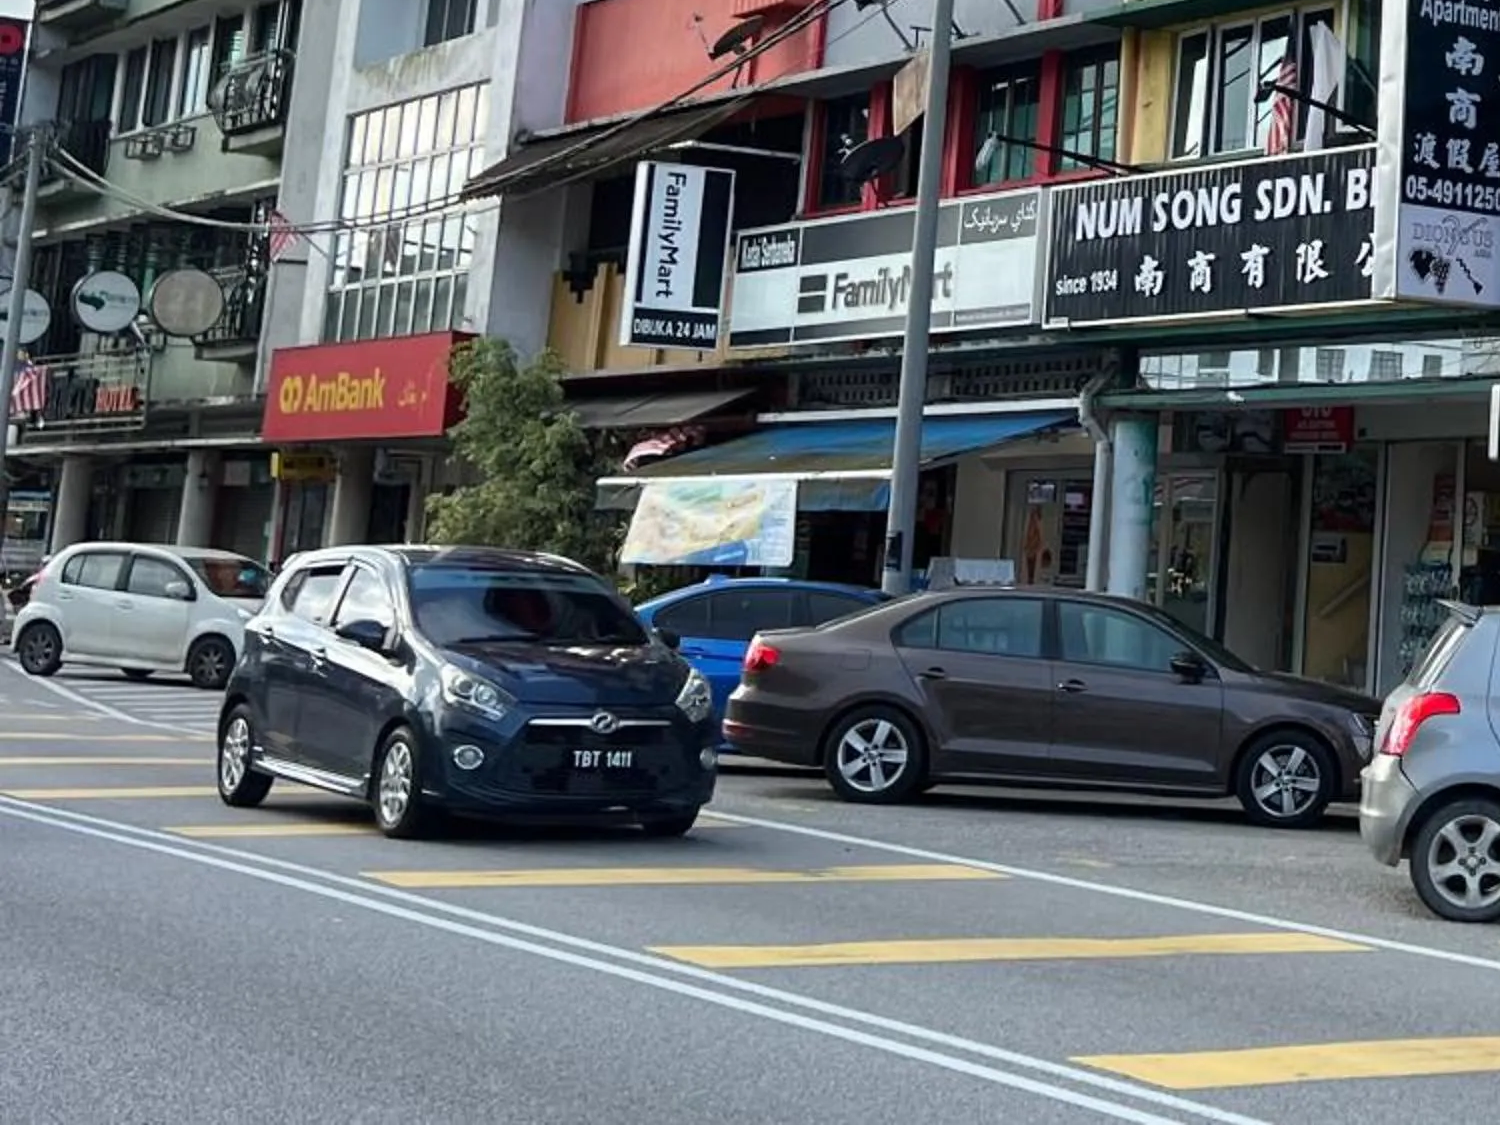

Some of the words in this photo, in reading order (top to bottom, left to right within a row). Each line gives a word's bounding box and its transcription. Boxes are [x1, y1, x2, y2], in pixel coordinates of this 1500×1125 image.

[1076, 196, 1143, 241] NUM
[1152, 182, 1242, 232] SONG
[1254, 173, 1332, 221] SDN.
[655, 171, 687, 299] FamilyMart
[832, 261, 953, 311] Familyt
[1056, 275, 1087, 296] since
[1090, 269, 1118, 292] 1934
[633, 318, 674, 338] DIBUKA
[677, 320, 691, 337] 24
[692, 321, 717, 340] JAM
[304, 366, 386, 412] AmBank
[573, 750, 603, 768] TBT
[606, 750, 633, 768] 1411
